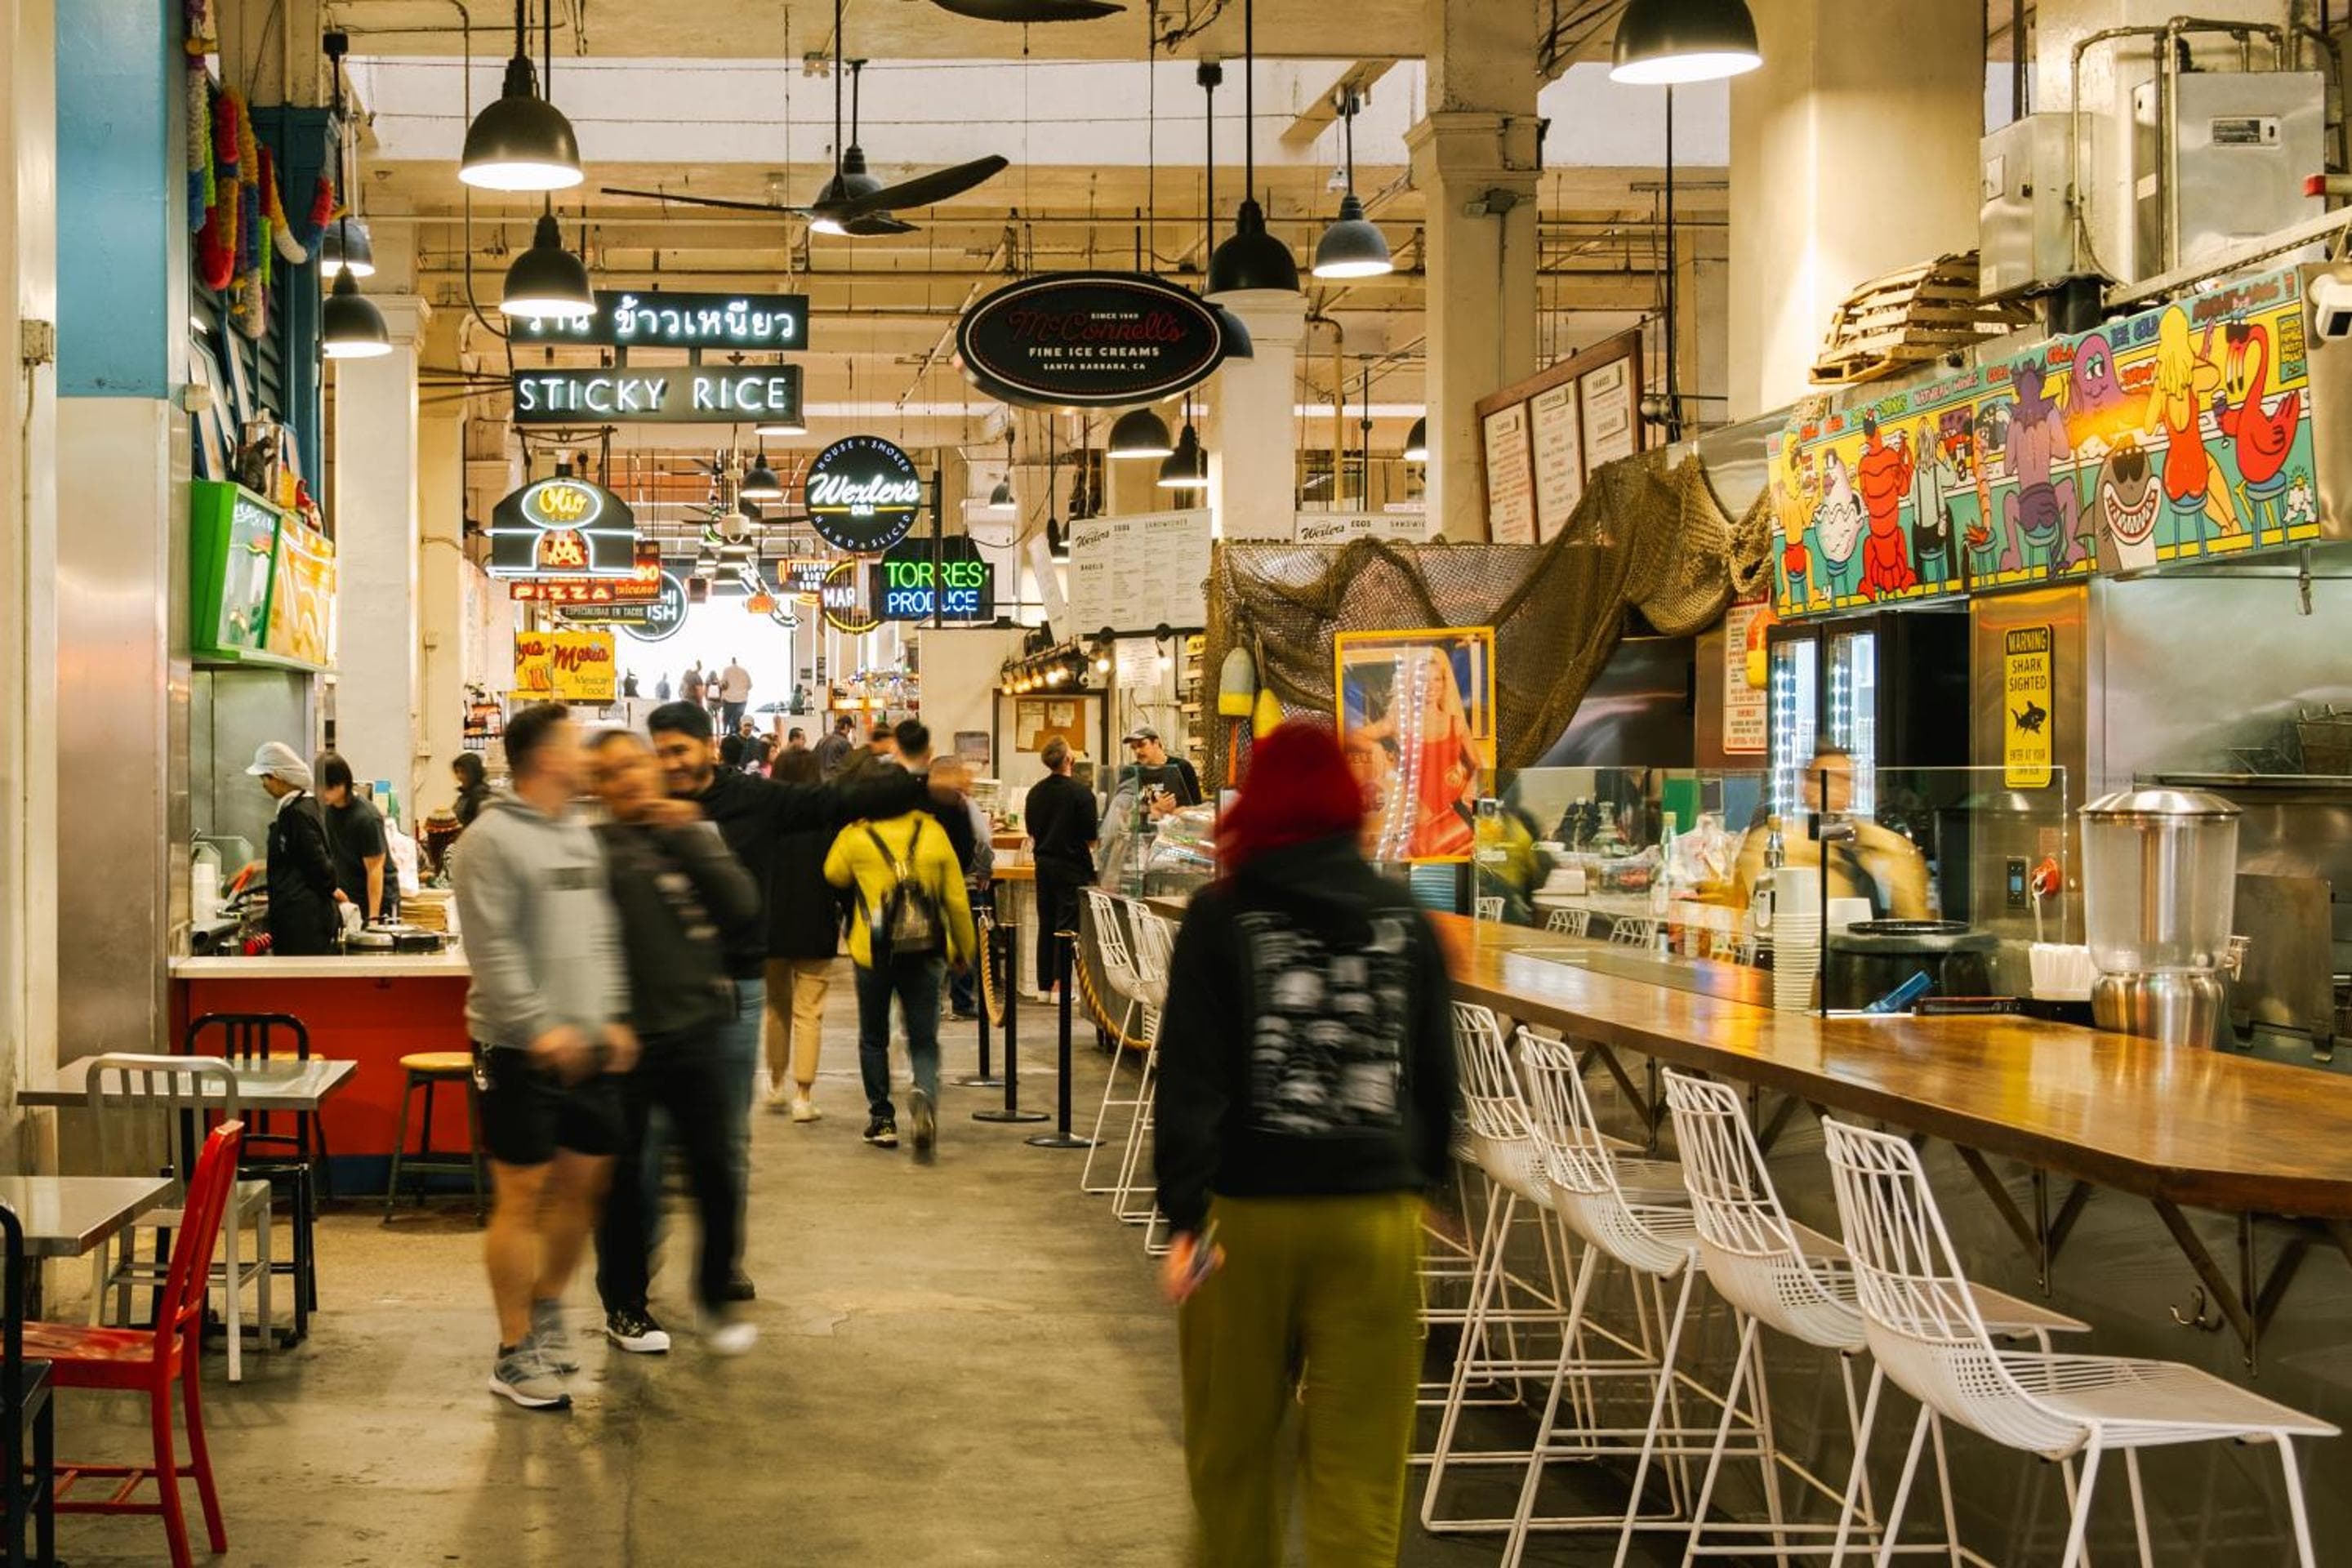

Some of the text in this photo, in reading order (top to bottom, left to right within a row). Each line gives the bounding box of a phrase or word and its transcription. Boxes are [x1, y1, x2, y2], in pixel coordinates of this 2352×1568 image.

[614, 294, 795, 337] ข้าวเหนียว
[1009, 310, 1186, 342] McConnell's
[1029, 346, 1160, 358] FINE ICE CREAMS
[1044, 363, 1075, 371] SANTA
[1080, 363, 1129, 371] BARBARA,
[519, 376, 786, 412] STICKY RICE
[817, 439, 911, 473] HOUSE SMOKED
[539, 487, 588, 514] Olio
[807, 472, 921, 504] Wexler's
[815, 514, 911, 548] HAND SLICED
[884, 561, 983, 588] TORRES
[514, 584, 609, 600] PIZZA
[647, 604, 677, 621] ISH
[2007, 628, 2047, 653] WARNING
[2011, 658, 2042, 674] SHARK
[2008, 675, 2047, 693] SIGHTED
